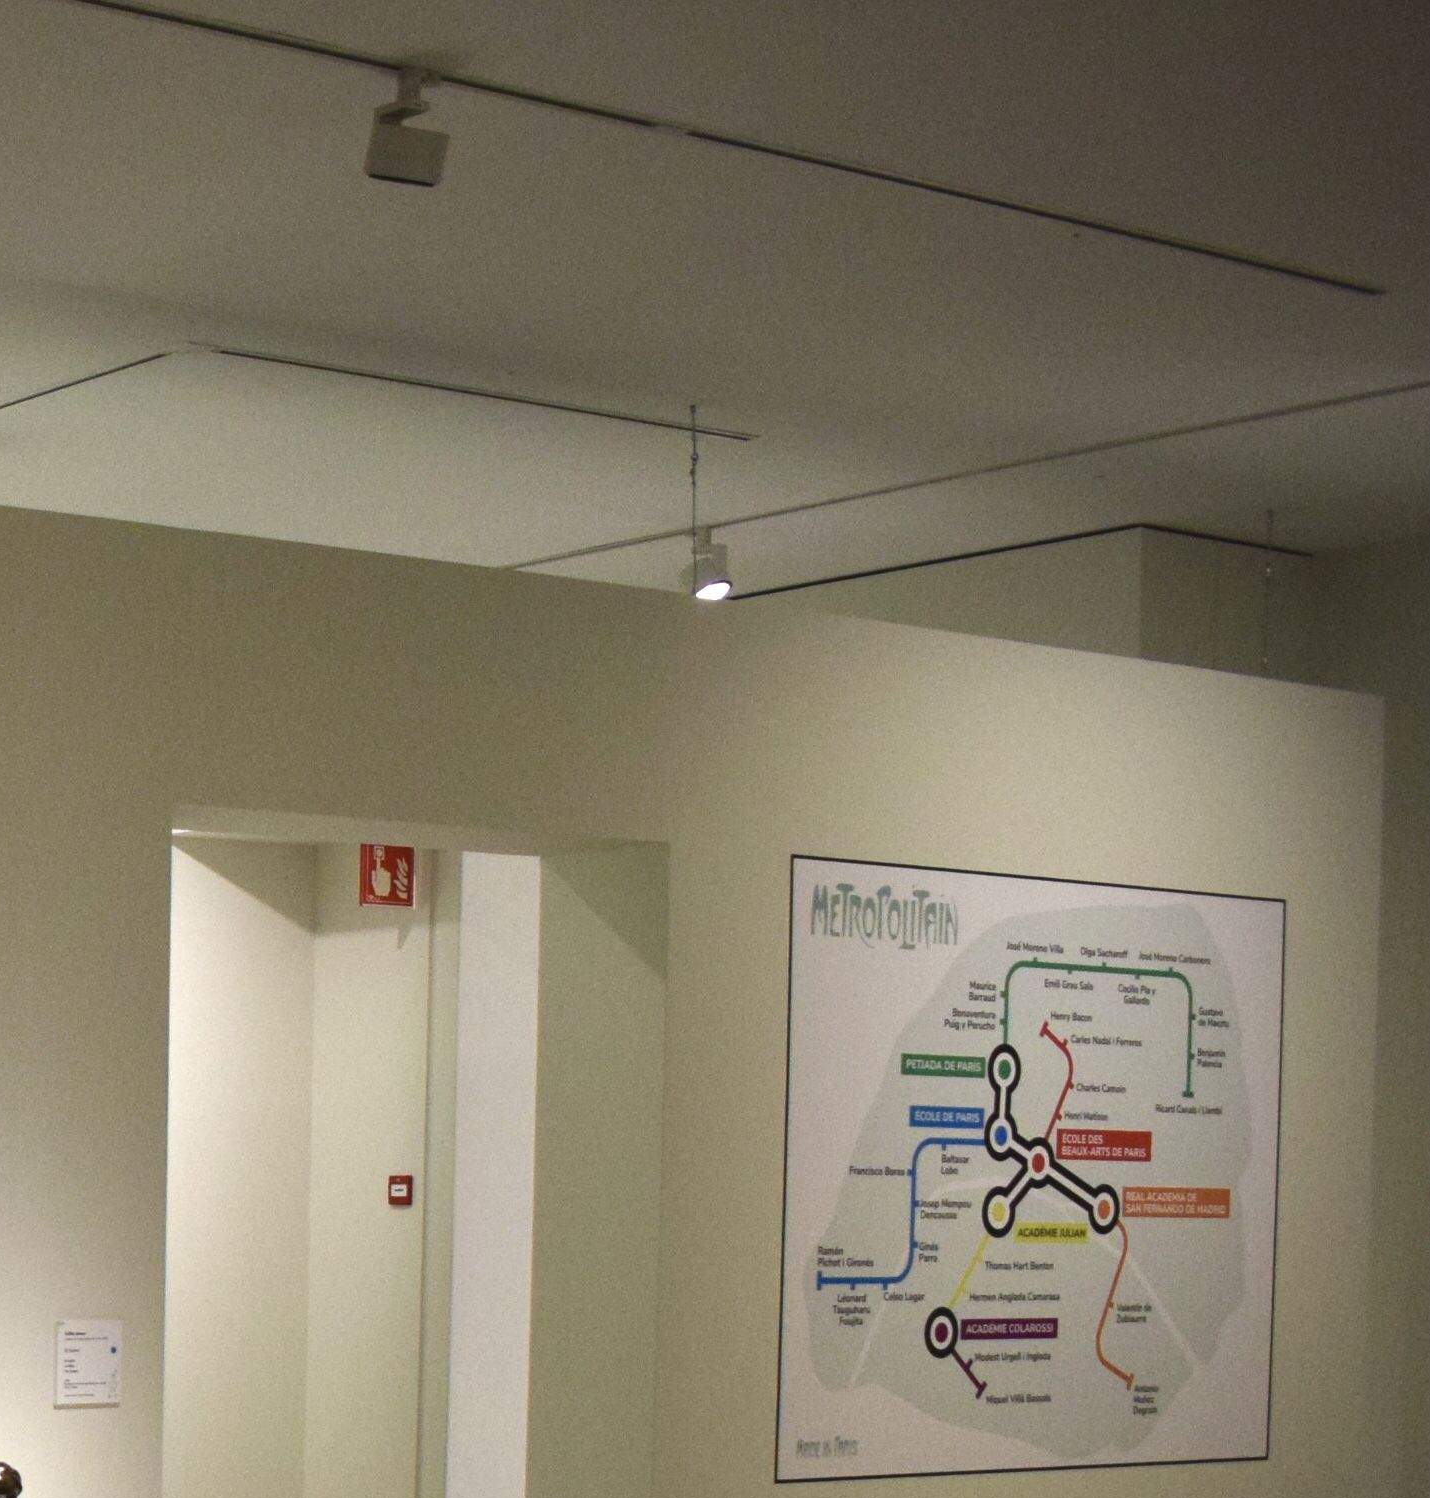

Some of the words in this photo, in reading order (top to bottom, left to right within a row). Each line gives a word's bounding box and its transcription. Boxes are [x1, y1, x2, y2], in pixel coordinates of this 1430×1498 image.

[944, 1060, 955, 1070] DE
[957, 1061, 981, 1072] PARIS
[943, 1112, 953, 1122] DE
[955, 1112, 980, 1123] PARIS
[1088, 1134, 1104, 1144] DES
[1061, 1146, 1110, 1156] BEAUX-ARTS
[1112, 1148, 1123, 1156] DE
[1123, 1148, 1147, 1158] PARIS
